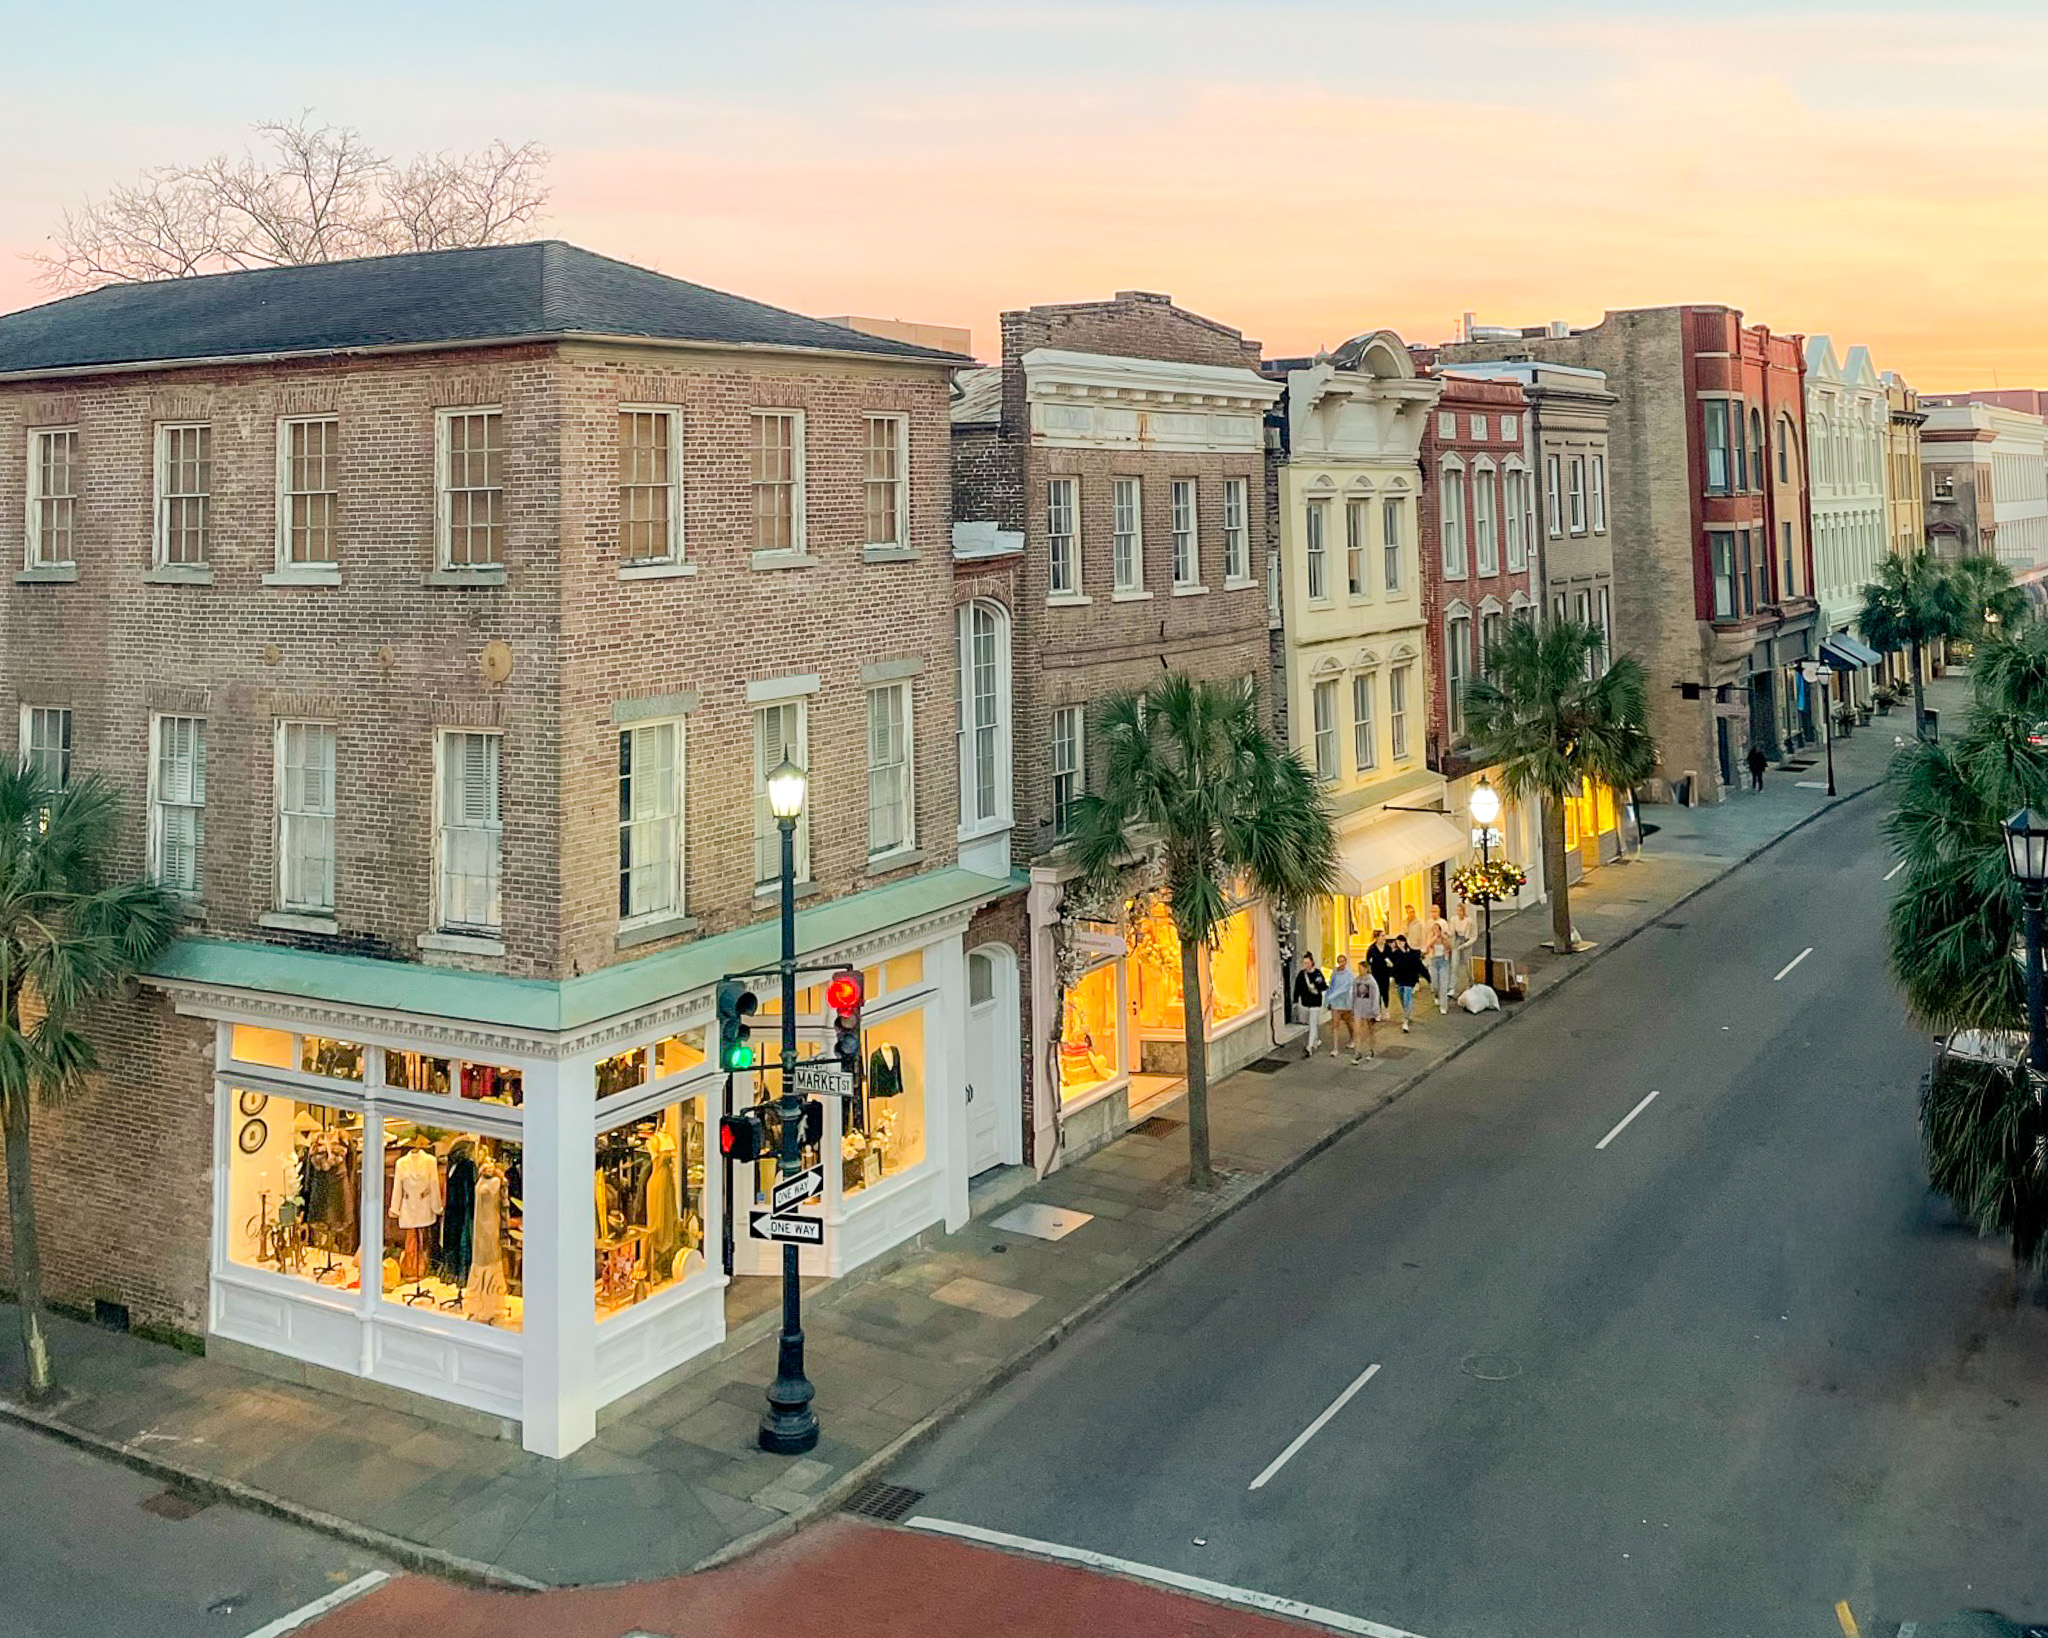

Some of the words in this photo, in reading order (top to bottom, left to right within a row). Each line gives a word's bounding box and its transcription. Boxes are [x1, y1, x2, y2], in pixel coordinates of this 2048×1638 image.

[797, 1071, 841, 1092] MARKET
[841, 1080, 850, 1091] ST
[777, 1188, 792, 1204] ONE
[794, 1180, 809, 1196] WAY
[770, 1221, 791, 1234] ONE
[794, 1223, 816, 1236] WAY
